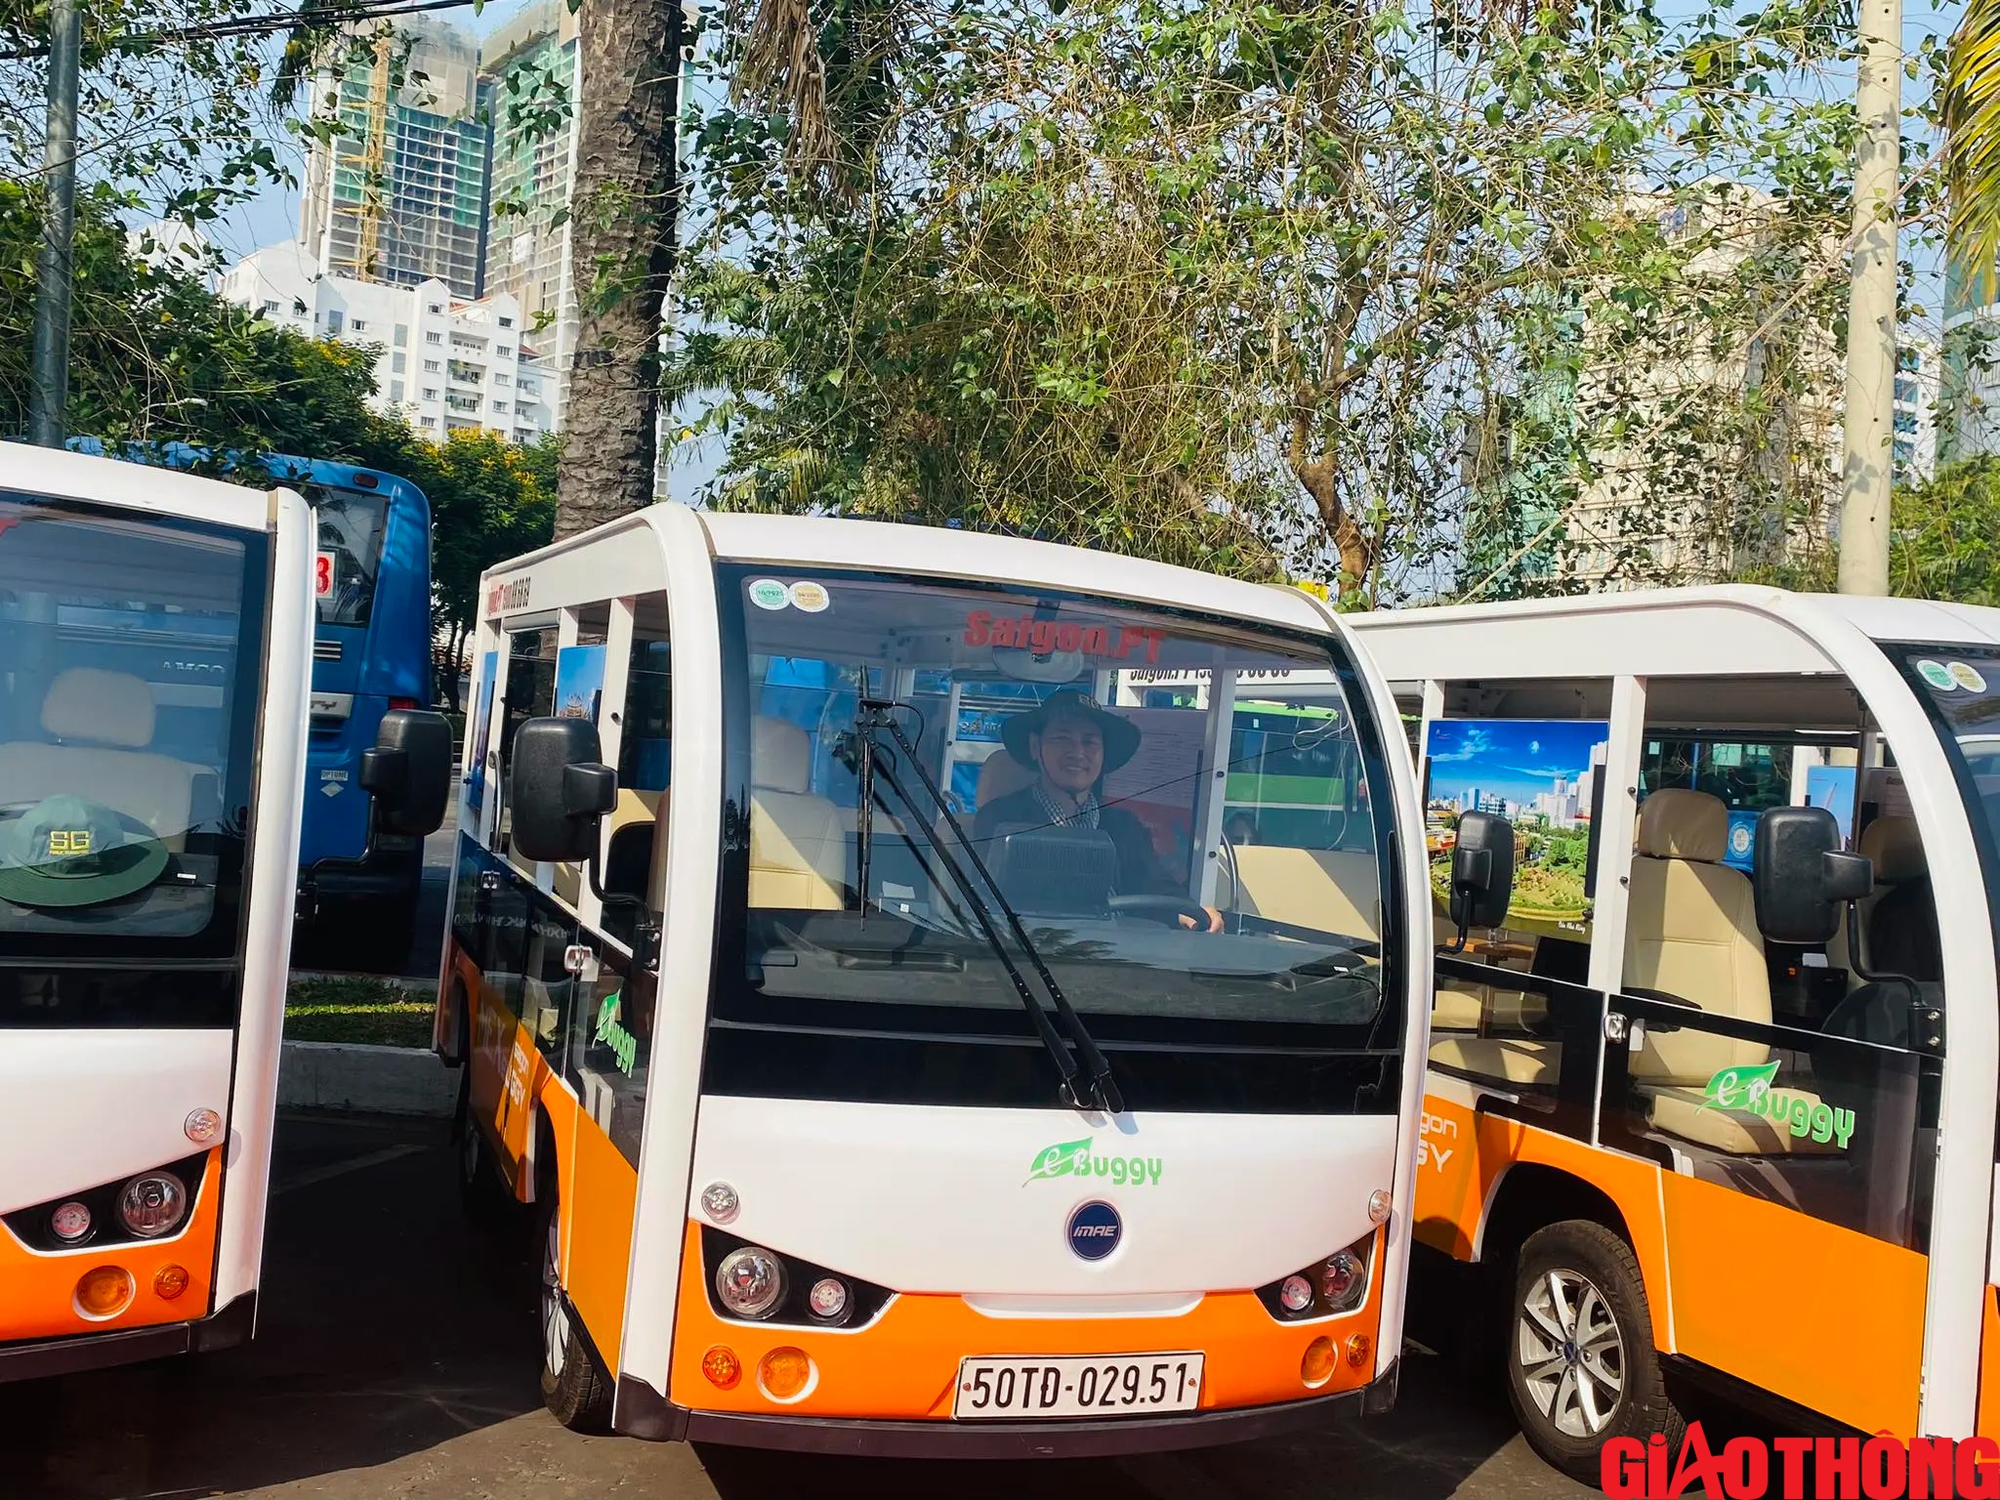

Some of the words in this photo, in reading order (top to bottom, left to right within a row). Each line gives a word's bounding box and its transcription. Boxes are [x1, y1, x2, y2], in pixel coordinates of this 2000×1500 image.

[963, 609, 1167, 664] Saigon.PT
[49, 830, 90, 850] SG
[1421, 1111, 1457, 1140] gon
